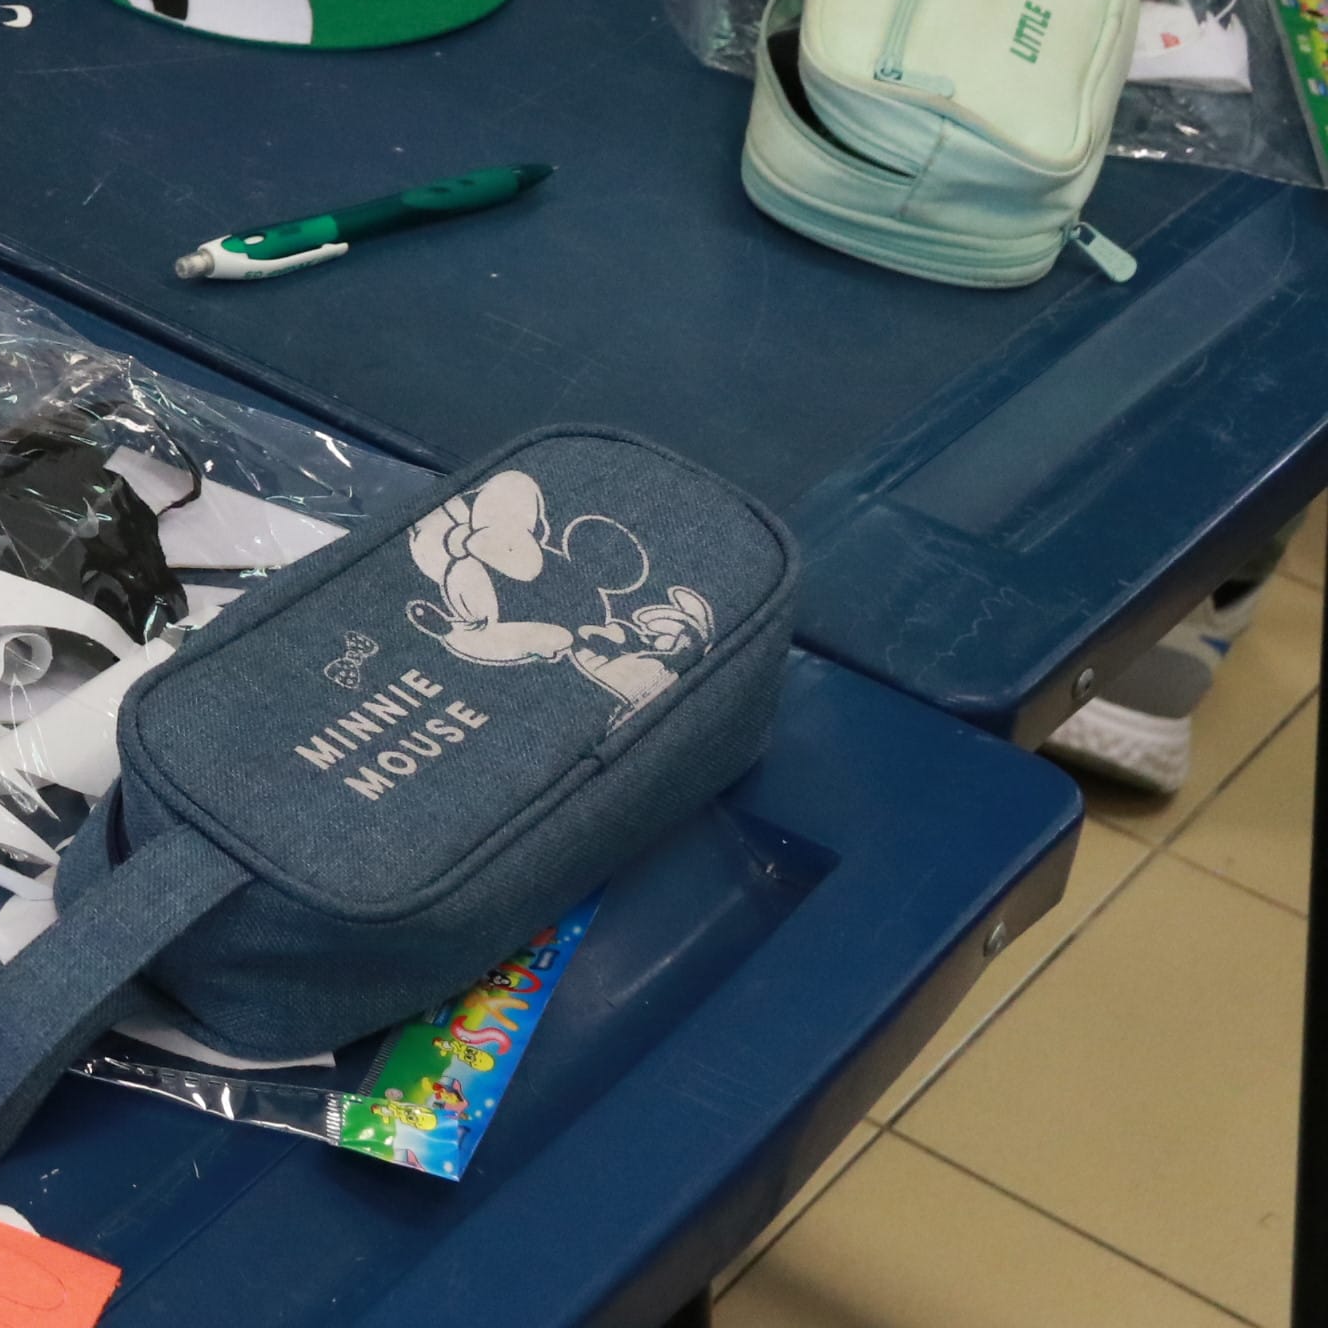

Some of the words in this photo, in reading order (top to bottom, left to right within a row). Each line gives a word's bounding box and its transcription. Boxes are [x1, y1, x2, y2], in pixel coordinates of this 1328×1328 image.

[1009, 0, 1052, 64] LITTLE
[295, 668, 444, 770] MINNIE
[343, 699, 491, 801] MOUSE
